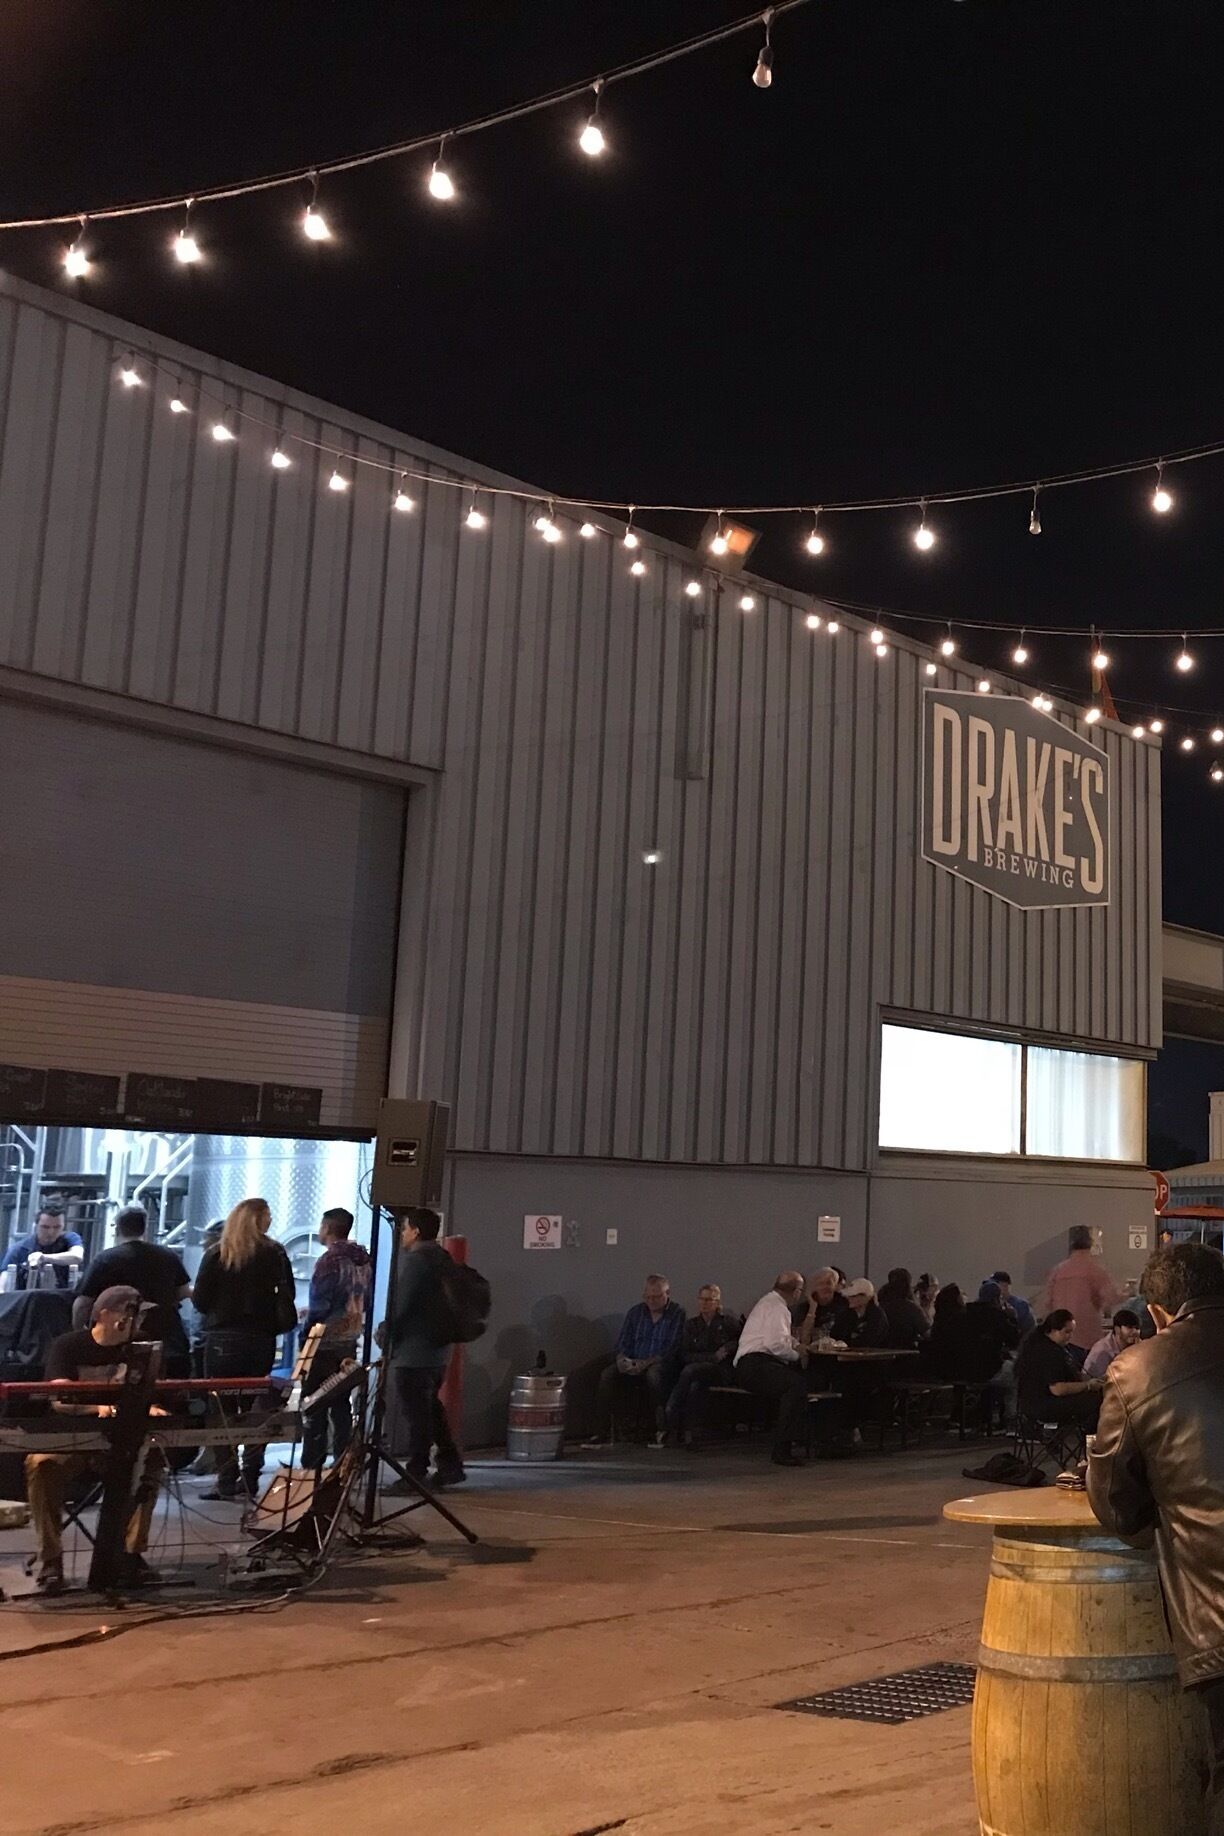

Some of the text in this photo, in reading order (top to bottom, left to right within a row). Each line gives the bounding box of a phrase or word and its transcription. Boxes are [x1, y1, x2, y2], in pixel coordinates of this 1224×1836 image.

[932, 702, 1104, 894] DRAKE'S
[983, 847, 1075, 889] BREWING
[1155, 1184, 1168, 1200] OP
